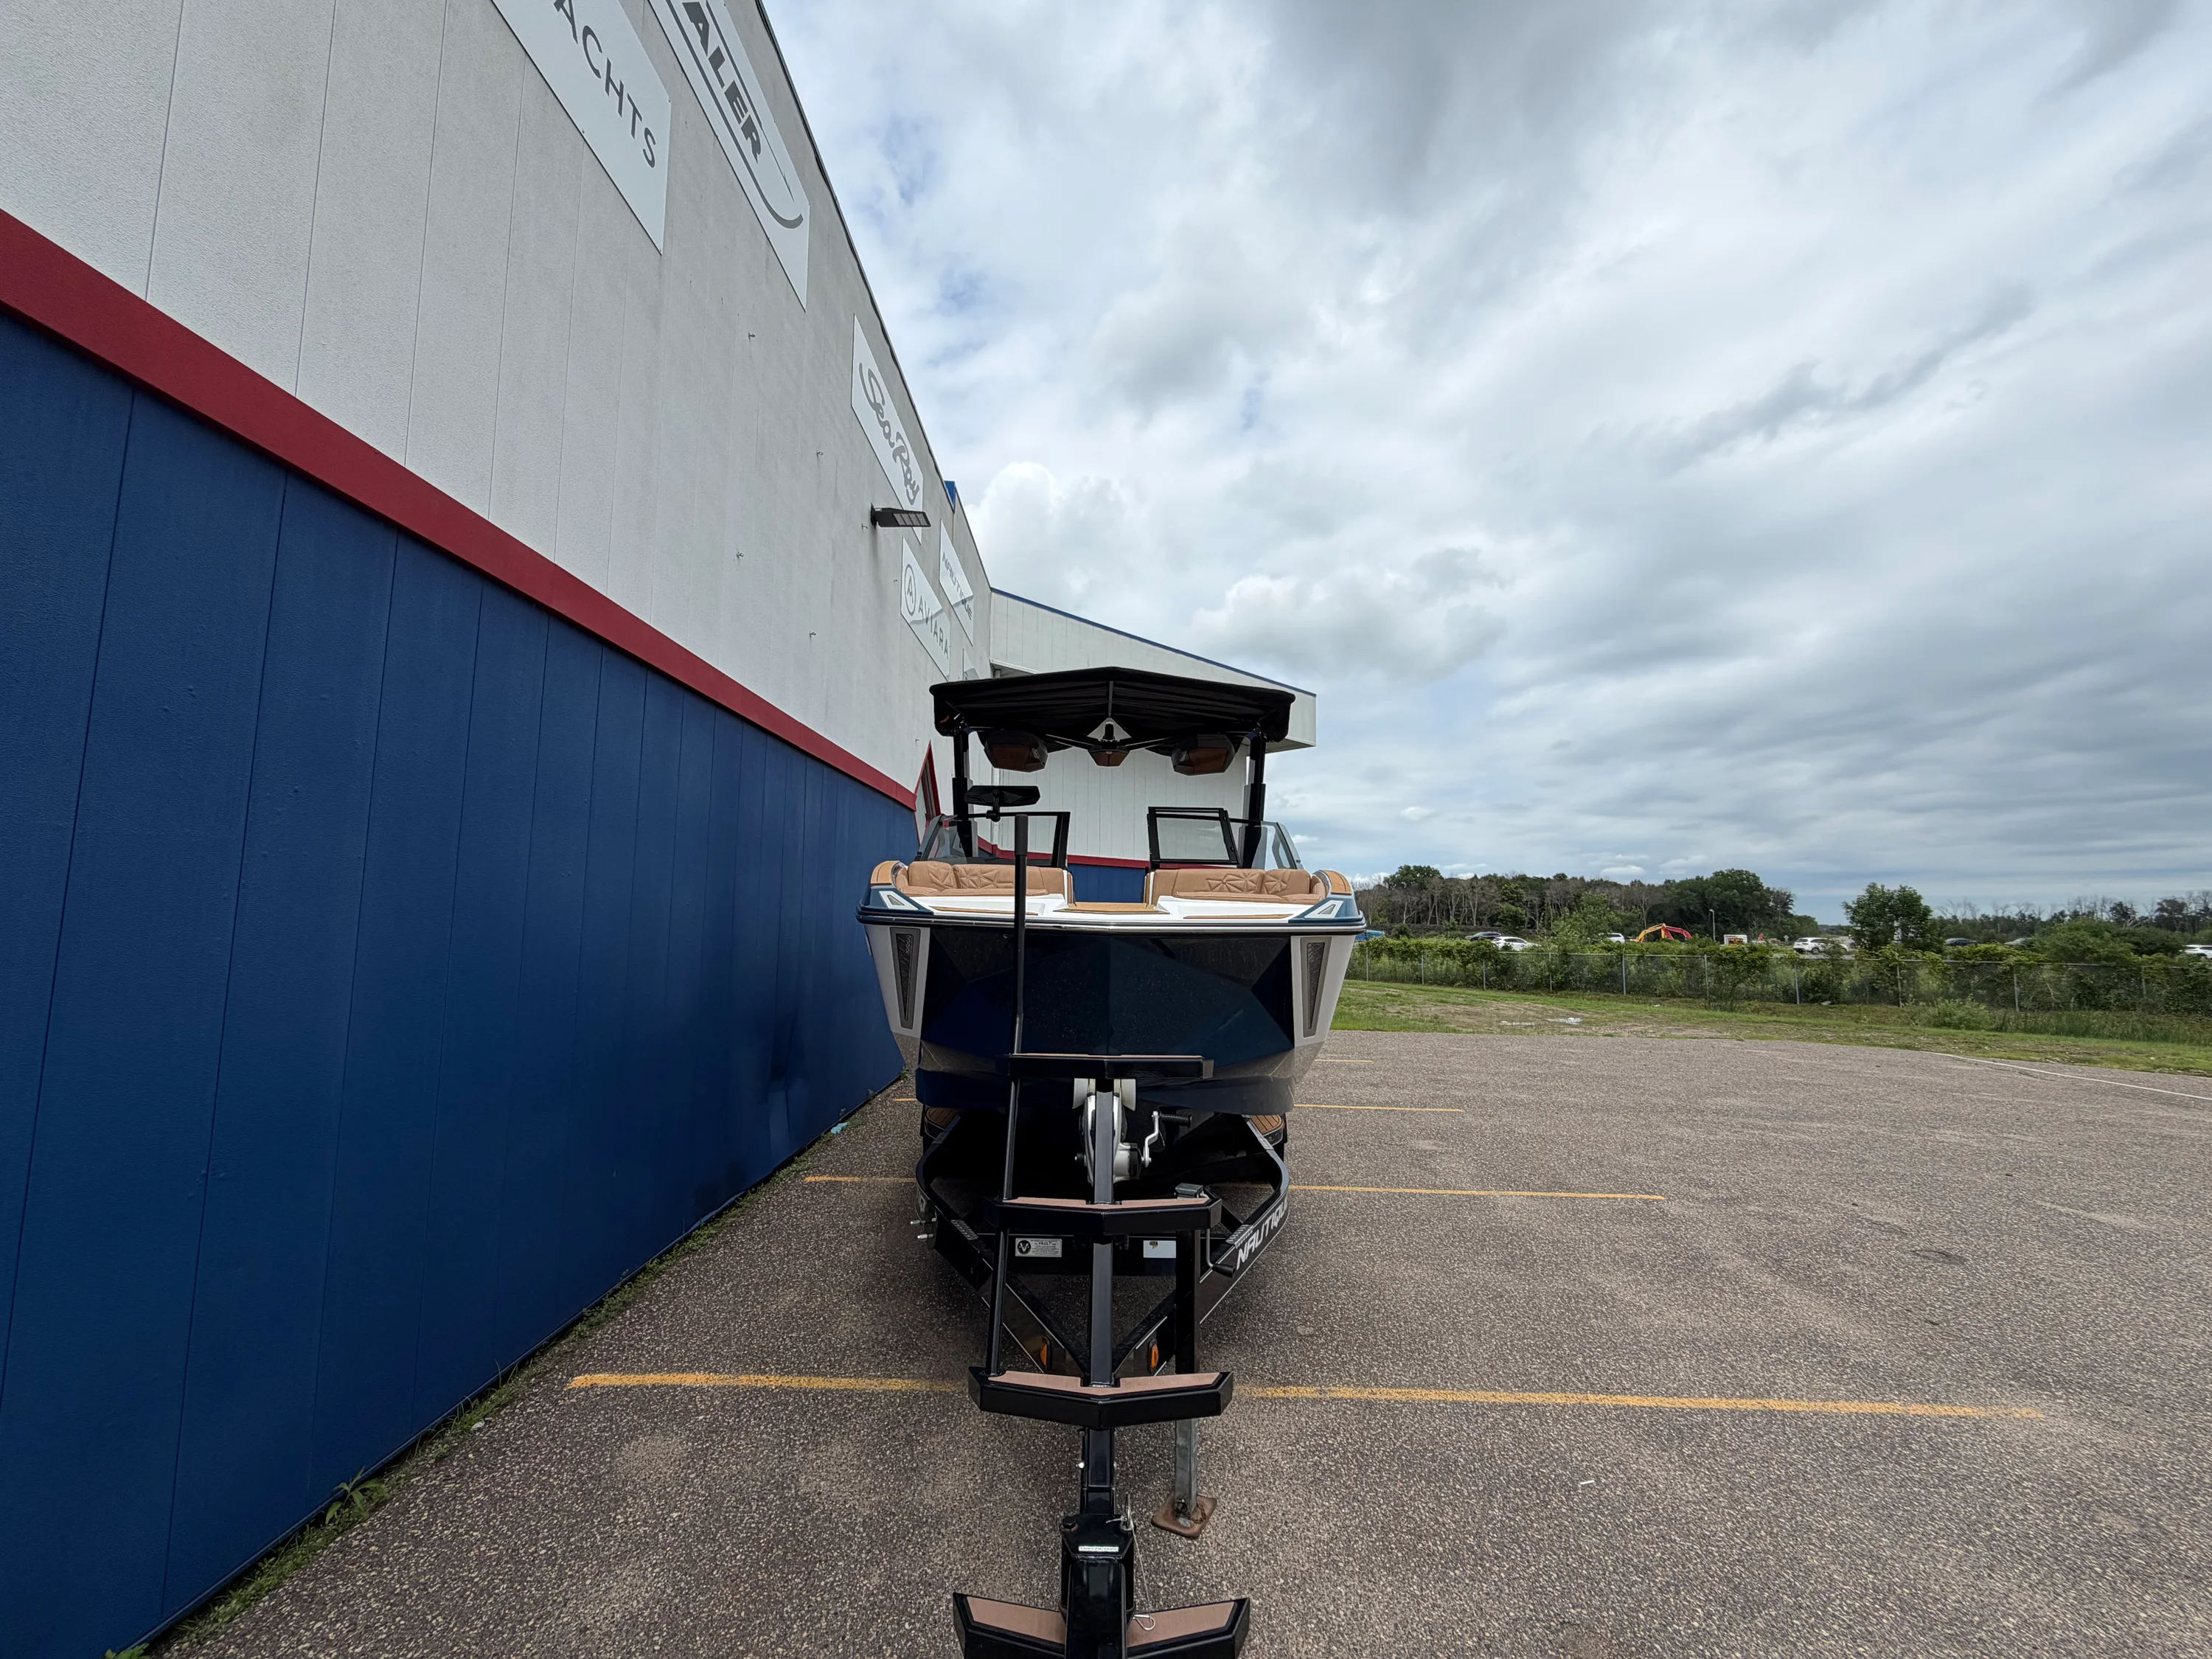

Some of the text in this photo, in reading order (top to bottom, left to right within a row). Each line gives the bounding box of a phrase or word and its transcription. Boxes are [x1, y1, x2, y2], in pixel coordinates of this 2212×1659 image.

[859, 362, 920, 506] Sea Ray
[942, 552, 973, 620] NAUTIQUE
[918, 594, 949, 660] AVIARA
